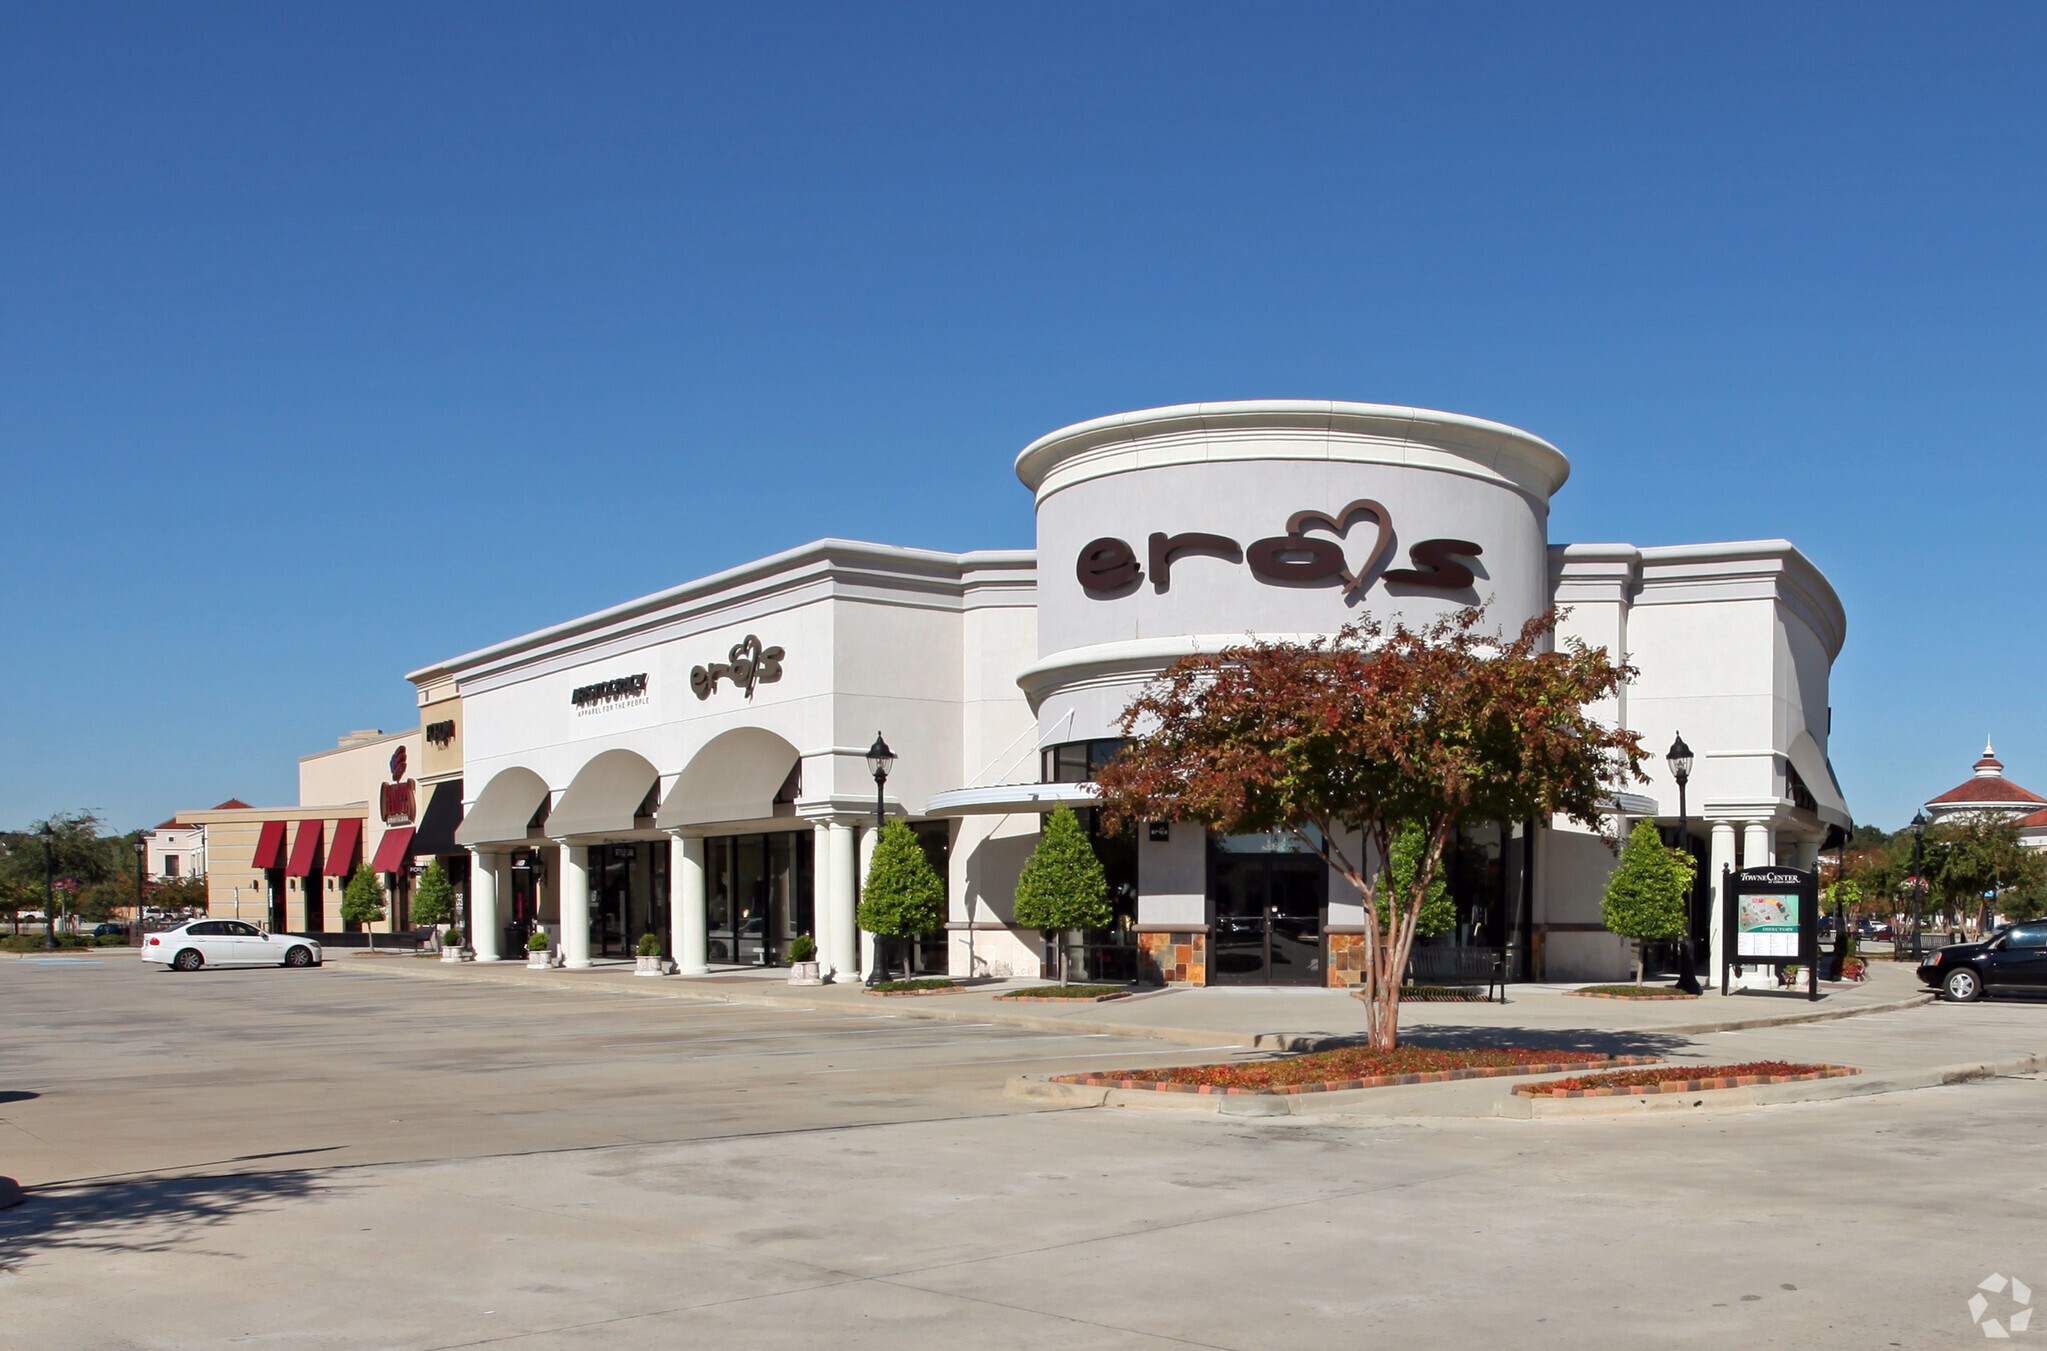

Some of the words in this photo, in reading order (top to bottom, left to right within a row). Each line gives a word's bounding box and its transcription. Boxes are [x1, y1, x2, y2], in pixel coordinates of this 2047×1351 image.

[1076, 499, 1484, 597] eros
[578, 707, 602, 717] APPAREL
[602, 704, 614, 713] FOR
[615, 702, 625, 710] THE
[627, 697, 649, 708] PEOPLE
